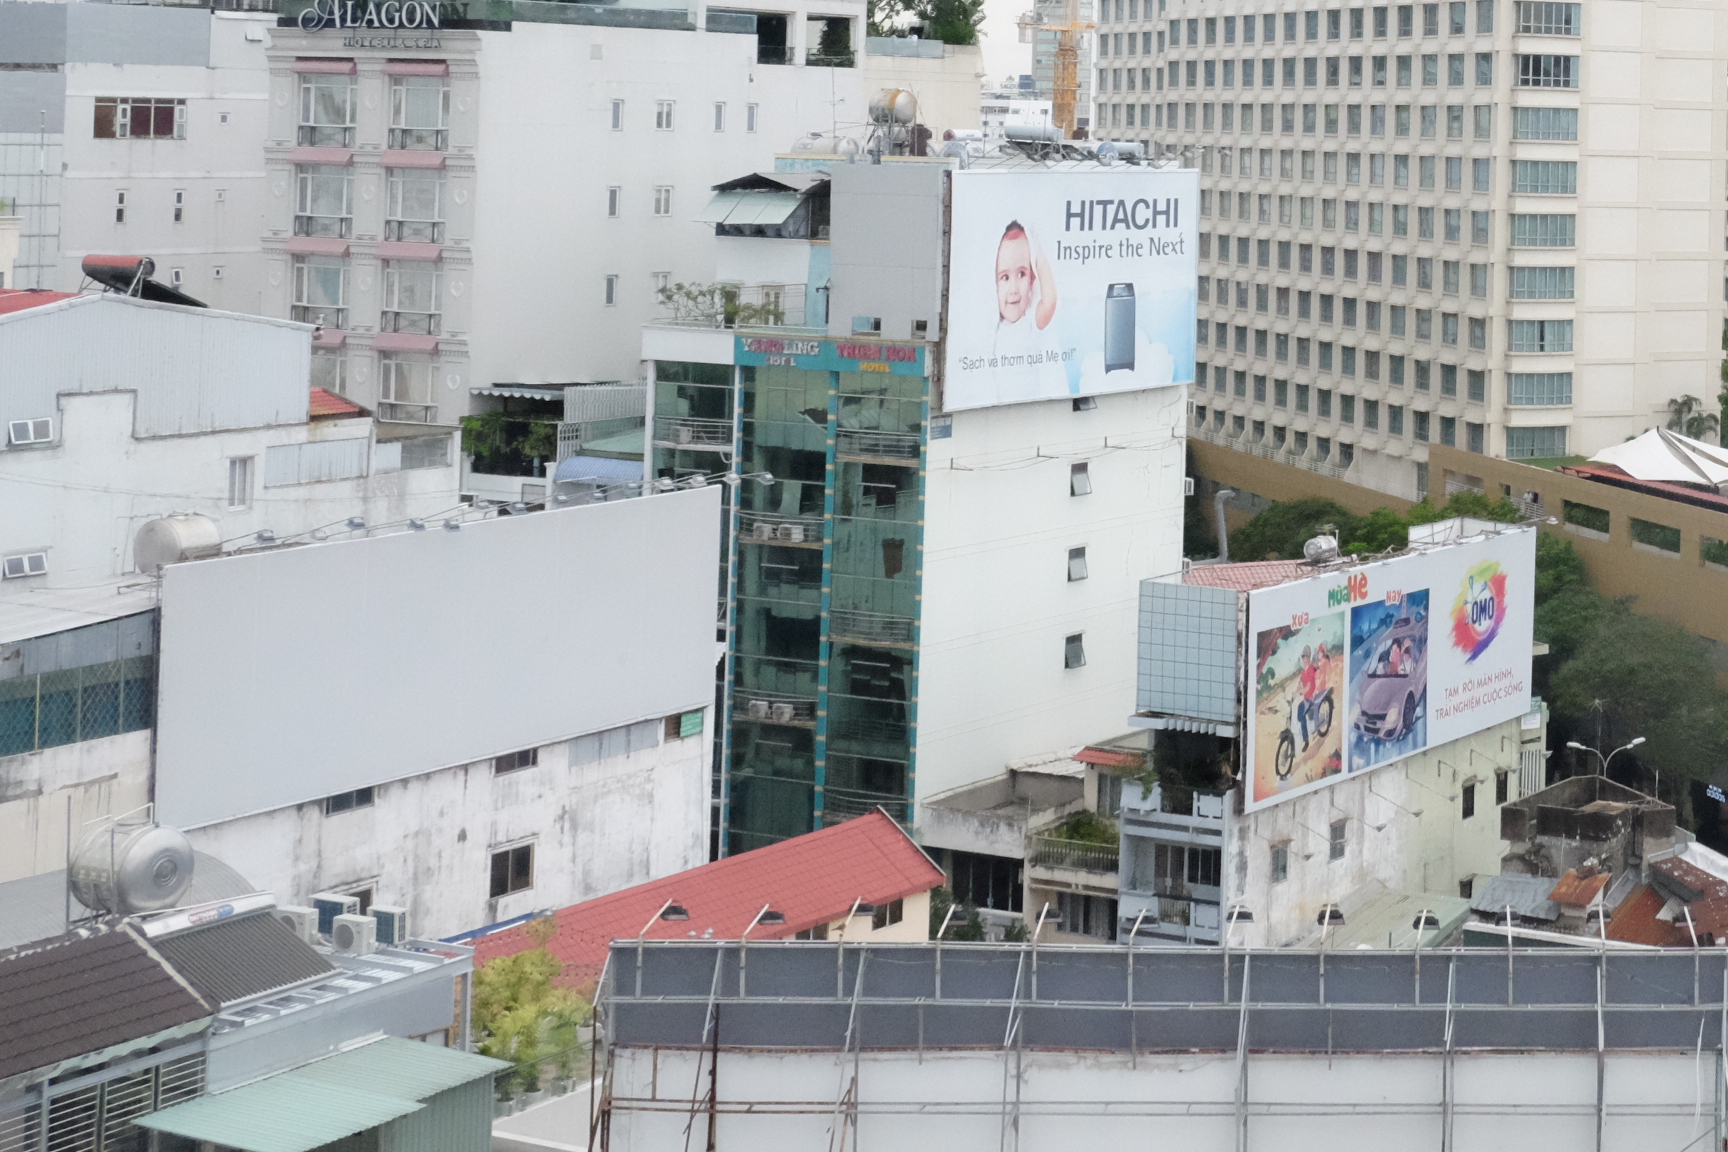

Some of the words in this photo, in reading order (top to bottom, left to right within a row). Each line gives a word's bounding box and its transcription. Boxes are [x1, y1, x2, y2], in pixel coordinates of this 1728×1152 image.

[1065, 198, 1178, 232] HITACHI
[1057, 239, 1113, 265] Inspire
[1119, 237, 1144, 258] the
[1149, 232, 1185, 256] Next
[860, 362, 891, 372] HOTEL
[1471, 596, 1495, 626] OMO
[1445, 685, 1459, 702] TẠM
[1452, 695, 1481, 716] NGHIỆM
[1482, 687, 1503, 705] CUỘC
[1706, 788, 1726, 803] adidas
